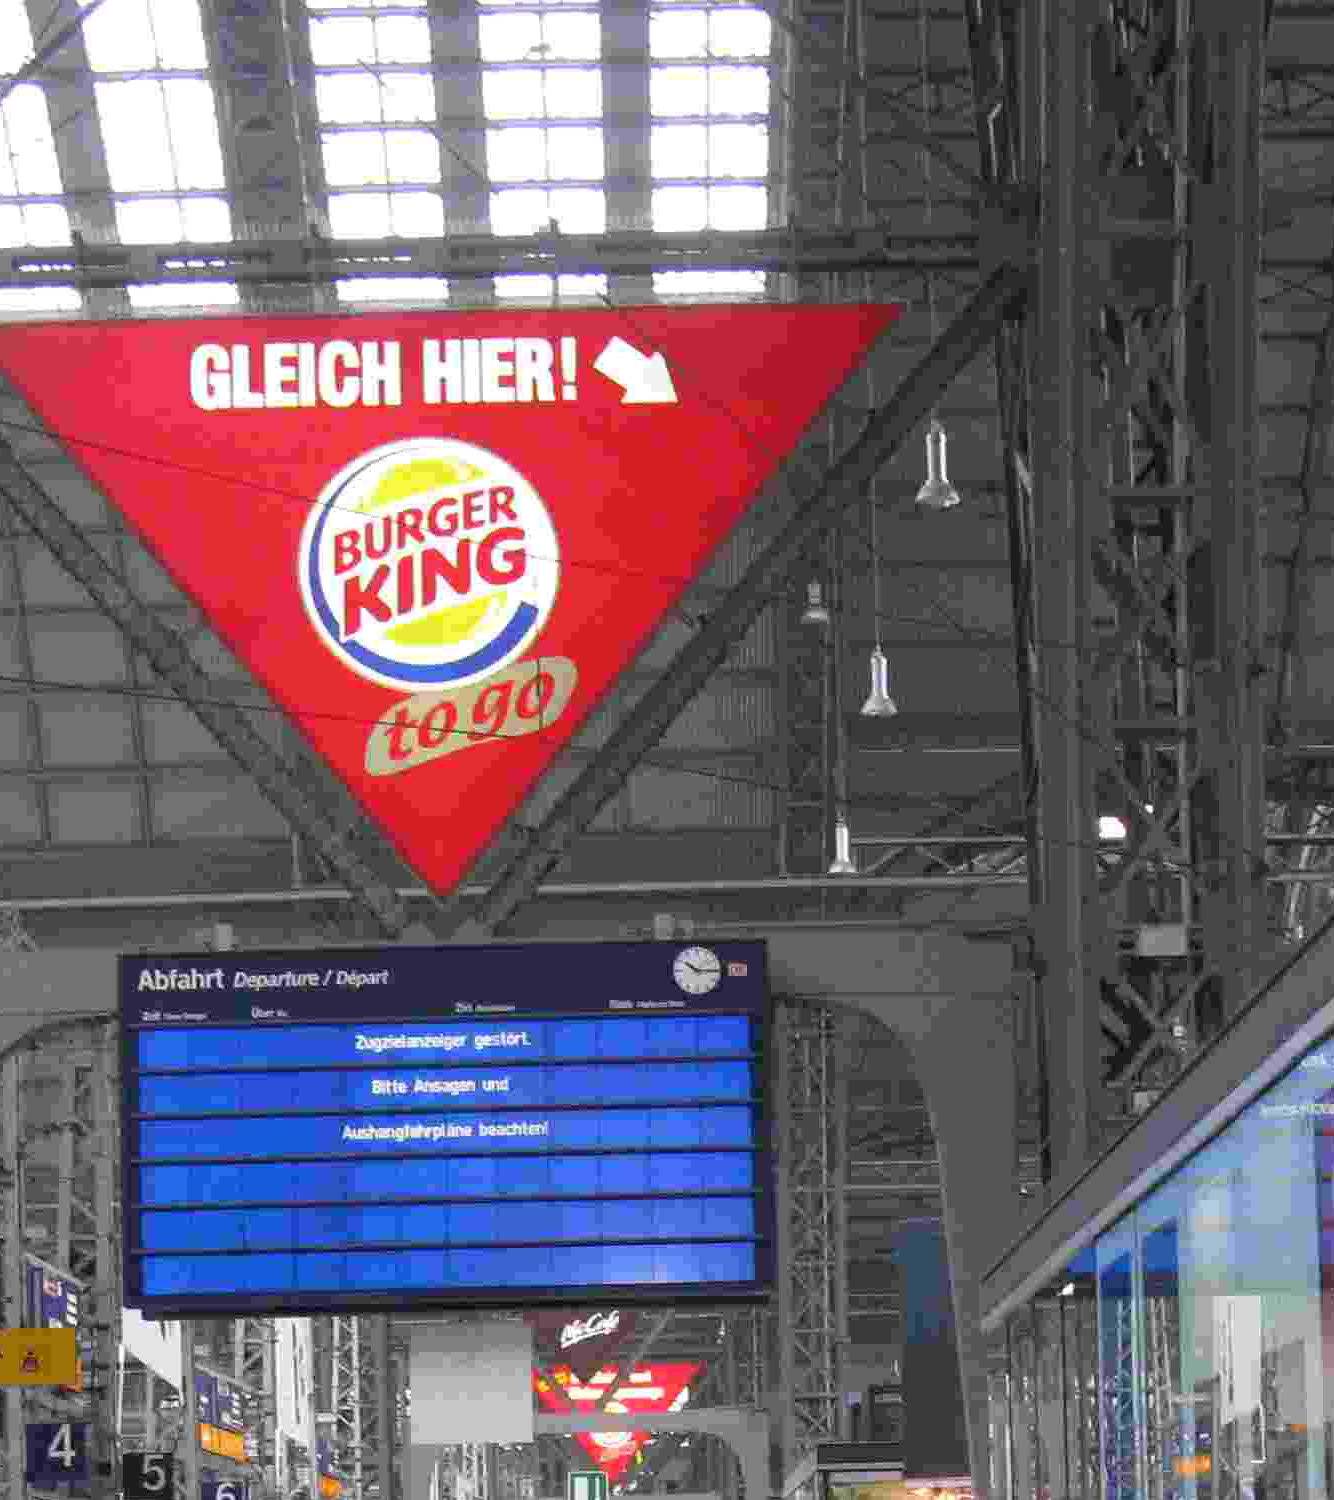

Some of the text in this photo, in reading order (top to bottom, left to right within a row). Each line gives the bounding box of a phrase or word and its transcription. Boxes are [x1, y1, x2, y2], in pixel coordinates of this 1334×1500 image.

[191, 336, 578, 410] GLEICH HIER!
[333, 484, 517, 572] BURGER
[341, 526, 527, 638] KING
[381, 669, 556, 762] to go
[138, 968, 225, 991] Abfahrt
[233, 970, 320, 992] Departure
[335, 969, 389, 988] Départ
[371, 1075, 509, 1096] Bitte Ansagen und
[48, 1424, 76, 1467] 4
[141, 1455, 167, 1491] 5
